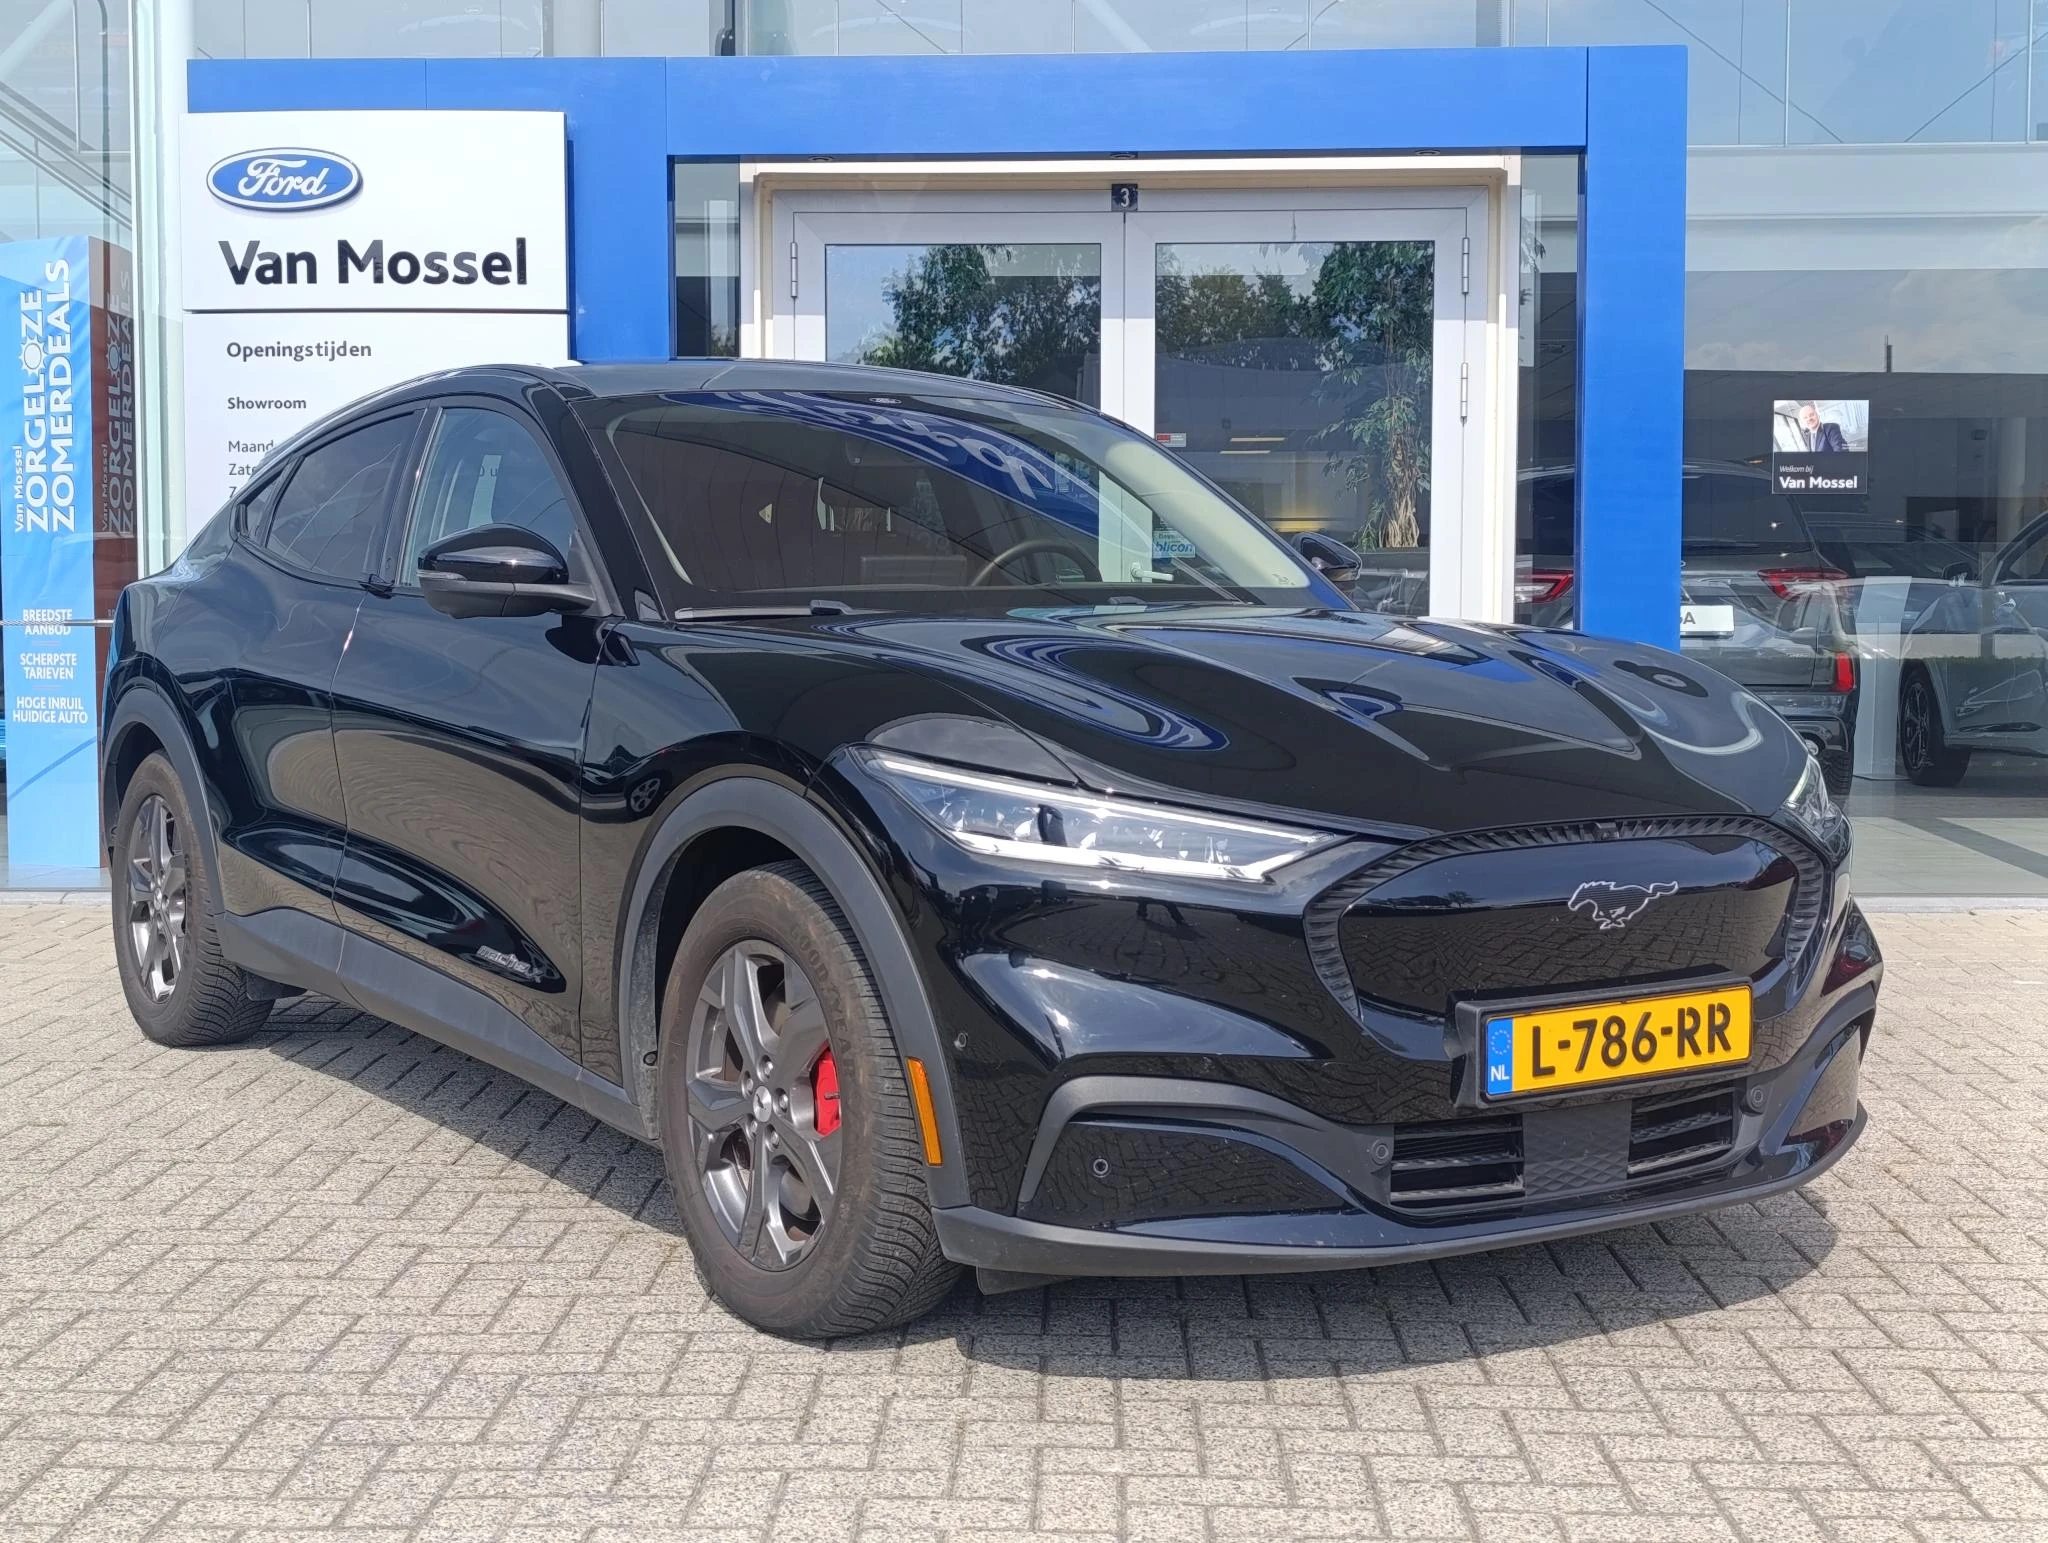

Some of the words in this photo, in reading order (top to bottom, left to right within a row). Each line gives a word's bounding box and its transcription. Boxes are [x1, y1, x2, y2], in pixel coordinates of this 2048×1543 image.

[237, 158, 330, 197] Ford
[1120, 187, 1130, 208] 3
[218, 240, 318, 285] Van
[337, 237, 528, 285] Mossel
[226, 341, 373, 362] Openingstijden
[45, 259, 76, 534] ZOMERDEALS
[227, 396, 307, 410] Showroom
[12, 444, 24, 499] Mossel
[101, 443, 109, 498] Mossel
[1779, 465, 1805, 473] Welkom
[1779, 476, 1806, 489] Van
[1809, 475, 1858, 489] Mossel
[14, 503, 25, 533] Van
[22, 608, 73, 622] BREEDSTE
[24, 623, 72, 635] AANBOD
[20, 653, 78, 666] SCHERPSTE
[24, 667, 74, 680] TARIEVEN
[16, 697, 47, 709] HOGE
[48, 697, 84, 710] INRUIL
[12, 710, 57, 723] HUIDIGE
[58, 711, 89, 724] AUTO
[1531, 1002, 1732, 1079] L-786-RR
[1490, 1064, 1510, 1082] NL
